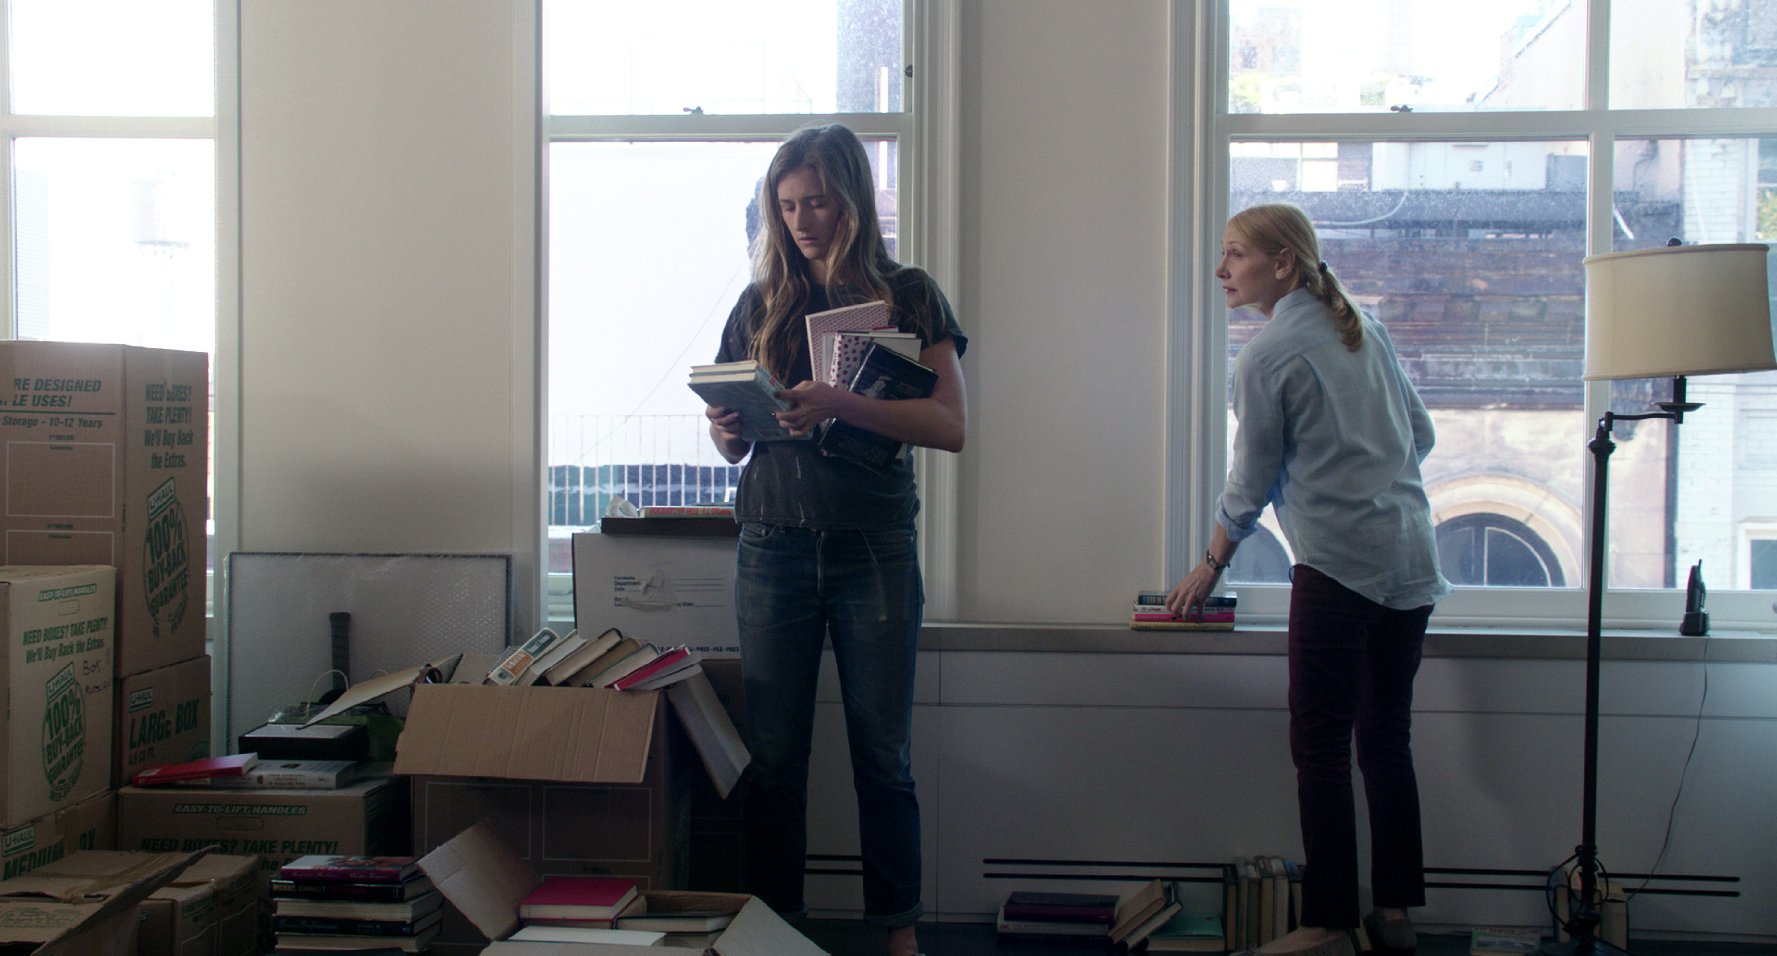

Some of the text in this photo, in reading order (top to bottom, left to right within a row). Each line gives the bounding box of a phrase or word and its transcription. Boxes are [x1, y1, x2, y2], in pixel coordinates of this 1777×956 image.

[13, 378, 102, 392] RE DESIGNED
[146, 383, 164, 401] NEED
[31, 395, 73, 407] USES!
[2, 416, 39, 428] Storage
[48, 417, 75, 428] 10-12
[78, 417, 104, 429] Years
[146, 406, 193, 424] TAKE PLENTY!
[144, 428, 194, 449] We'll Buy Back
[151, 452, 162, 469] the
[146, 508, 183, 563] 100%
[147, 542, 187, 594] BUY-BACK
[23, 629, 42, 645] NEED
[43, 624, 69, 642] BOXES?
[70, 620, 86, 638] TAKE
[26, 646, 43, 665] We'll
[44, 646, 58, 662] Buy
[58, 643, 74, 657] Back
[75, 640, 86, 654] the
[48, 668, 73, 693] U-HAUL
[46, 688, 81, 740] 100%
[175, 697, 200, 735] BOX
[46, 718, 83, 765] BUY-BACK
[48, 737, 84, 785] GUARANTEE
[175, 804, 307, 815] EASY-TO-LIFT HANDLES
[5, 828, 33, 848] U-HAUL
[79, 827, 96, 850] OX
[141, 838, 179, 852] NEED
[243, 839, 277, 853] TAKE
[281, 840, 338, 854] PLENTY!
